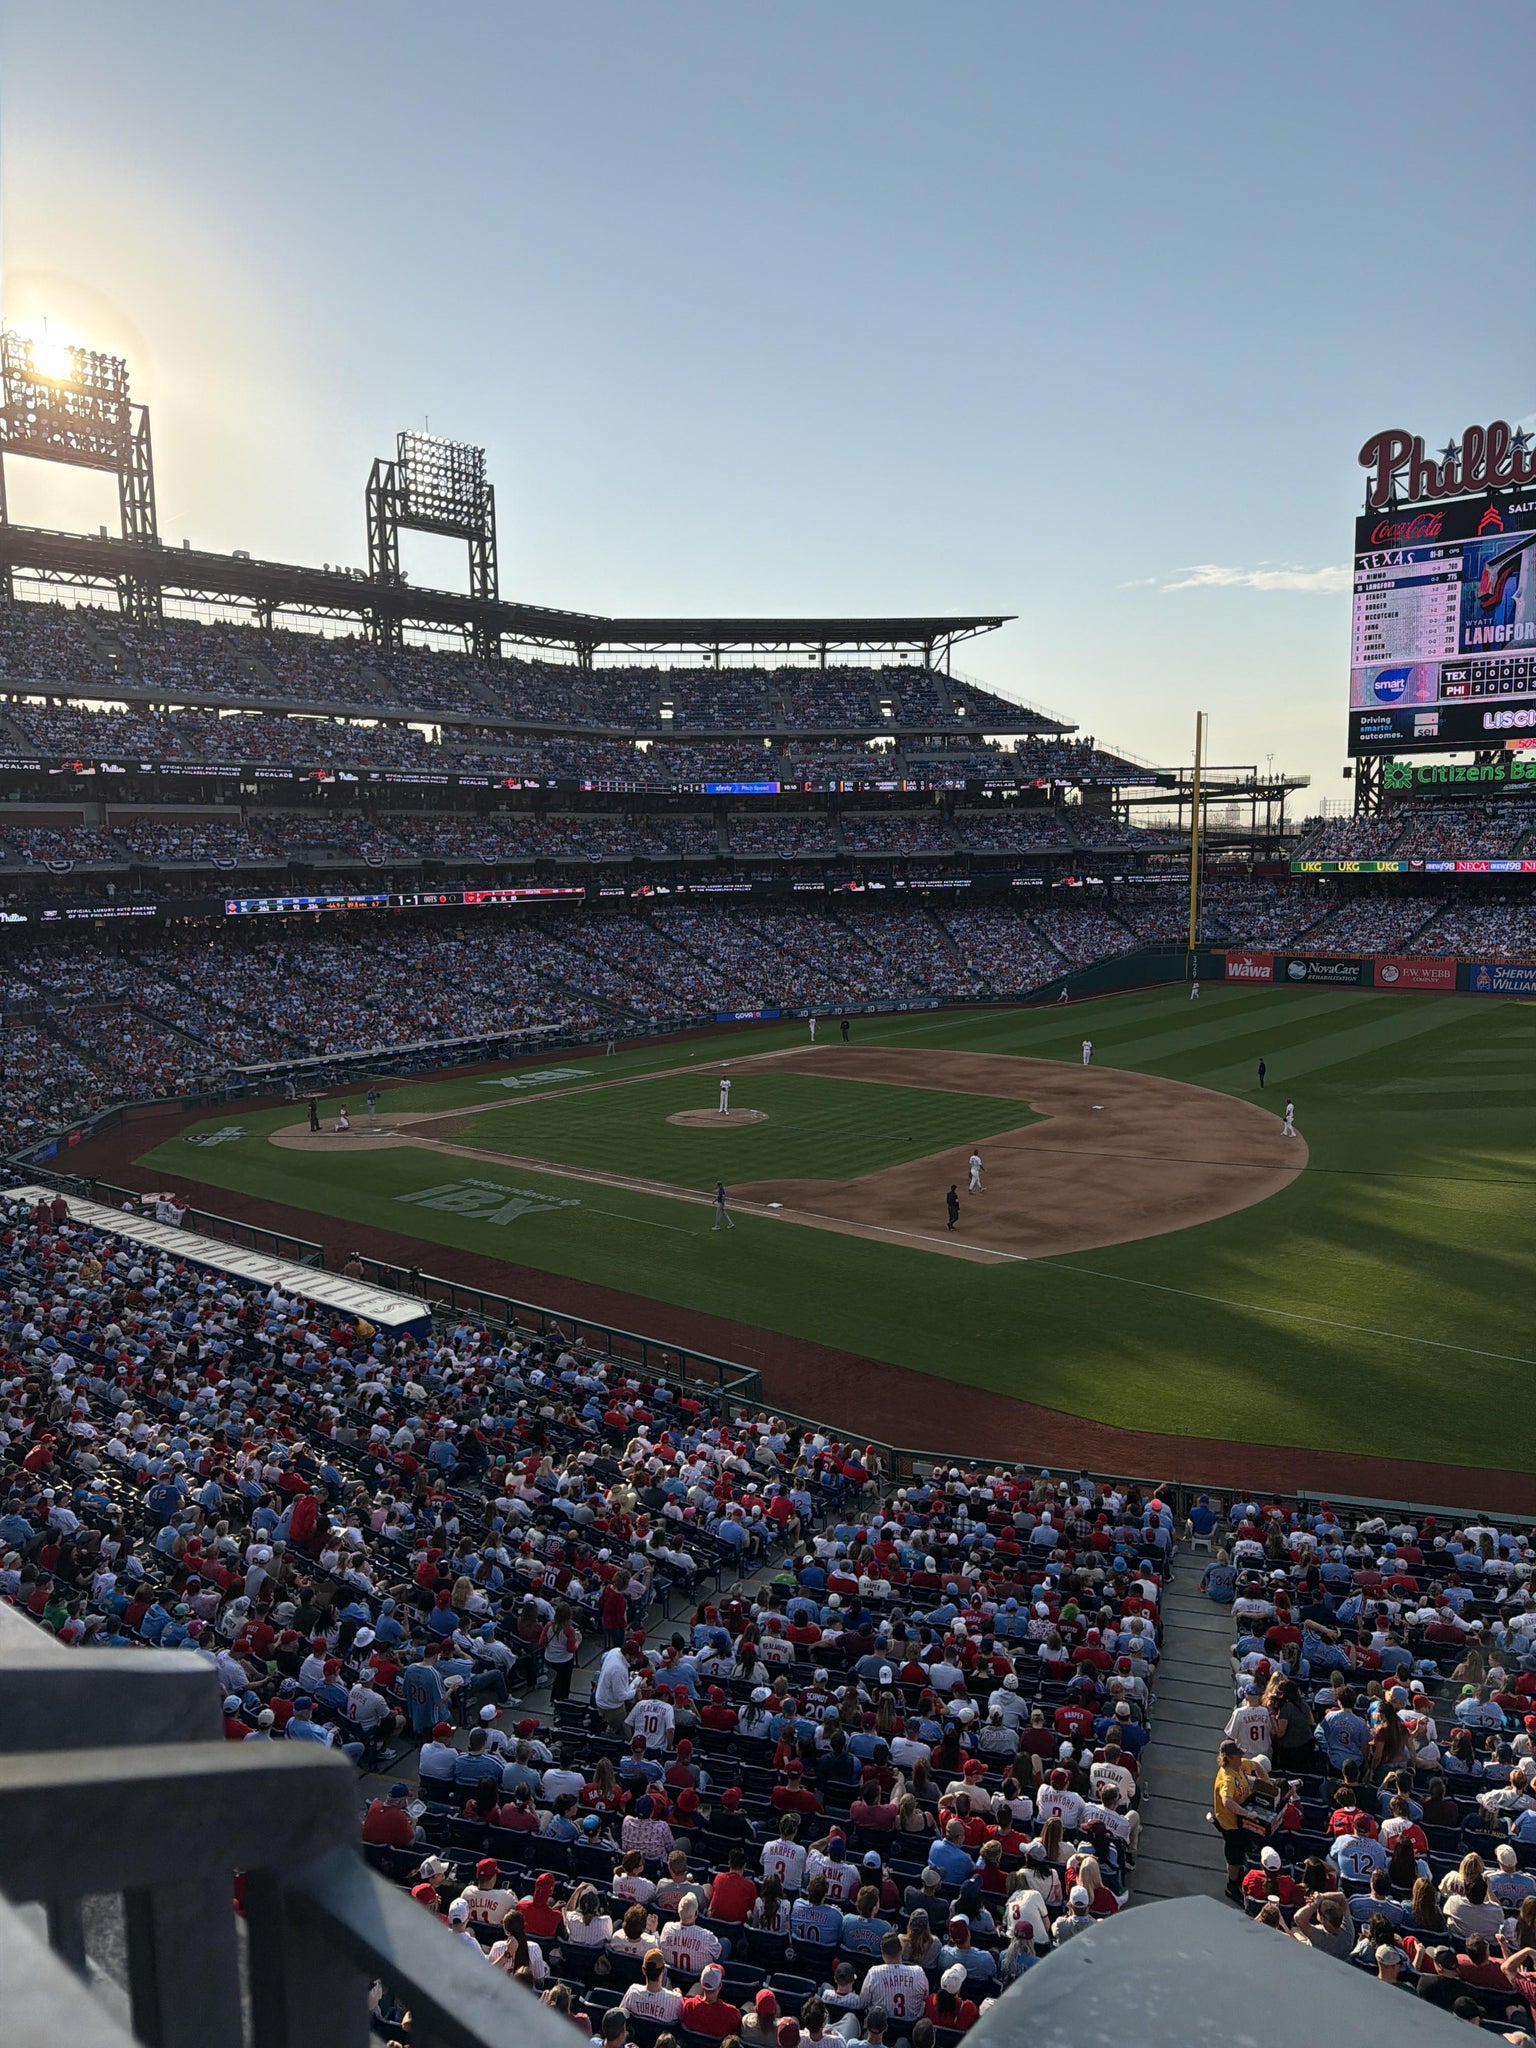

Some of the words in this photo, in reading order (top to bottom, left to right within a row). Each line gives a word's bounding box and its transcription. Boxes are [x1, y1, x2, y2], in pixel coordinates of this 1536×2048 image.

[1359, 550, 1416, 570] TEXAS
[1366, 582, 1395, 590] LANGFORD
[1465, 618, 1492, 626] WYATT
[1445, 671, 1466, 680] TEX
[1375, 679, 1405, 690] smart
[1446, 686, 1464, 695] PHI
[1484, 709, 1536, 729] LISCI
[1417, 764, 1505, 783] Citizens
[1510, 761, 1536, 779] Ba
[1300, 862, 1321, 871] UKG
[1338, 862, 1359, 871] UKG
[1376, 862, 1399, 871] UKG
[0, 912, 28, 922] Phillies
[1228, 963, 1270, 977] Wawa
[1308, 963, 1359, 974] NovaCare
[1422, 969, 1450, 977] WEBB
[1494, 967, 1536, 979] SHERW
[392, 1184, 562, 1226] IBX
[72, 1204, 250, 1266] PHILADELPHIA
[260, 1260, 409, 1315] PHILLIES
[152, 1490, 166, 1500] 42
[545, 1574, 555, 1584] 10
[1216, 1576, 1230, 1586] 34
[1064, 1634, 1071, 1643] 4
[762, 1642, 789, 1654] REALMUTO
[711, 1662, 719, 1674] 3
[411, 1686, 427, 1704] 20
[806, 1692, 829, 1703] SCHMIDT
[639, 1704, 666, 1715] REALMUTO
[805, 1704, 825, 1720] 20
[1064, 1712, 1083, 1720] HARPER
[644, 1715, 657, 1732] 10
[1244, 1715, 1268, 1724] SANCHEZ
[1250, 1725, 1265, 1740] 61
[1338, 1731, 1349, 1744] 3
[1094, 1769, 1123, 1782] HALLADAY
[1042, 1794, 1074, 1809] CRAWFORD
[770, 1846, 796, 1859] HARPER
[1350, 1853, 1374, 1874] 12
[775, 1861, 786, 1883] 3
[822, 1867, 844, 1882] KRUK
[797, 1923, 819, 1941] 10
[666, 1936, 701, 1952] REALMUTO
[672, 1951, 691, 1971] 10
[883, 1976, 913, 1987] HARPER
[635, 2001, 665, 2016] TURNER
[894, 1994, 905, 2016] 3
